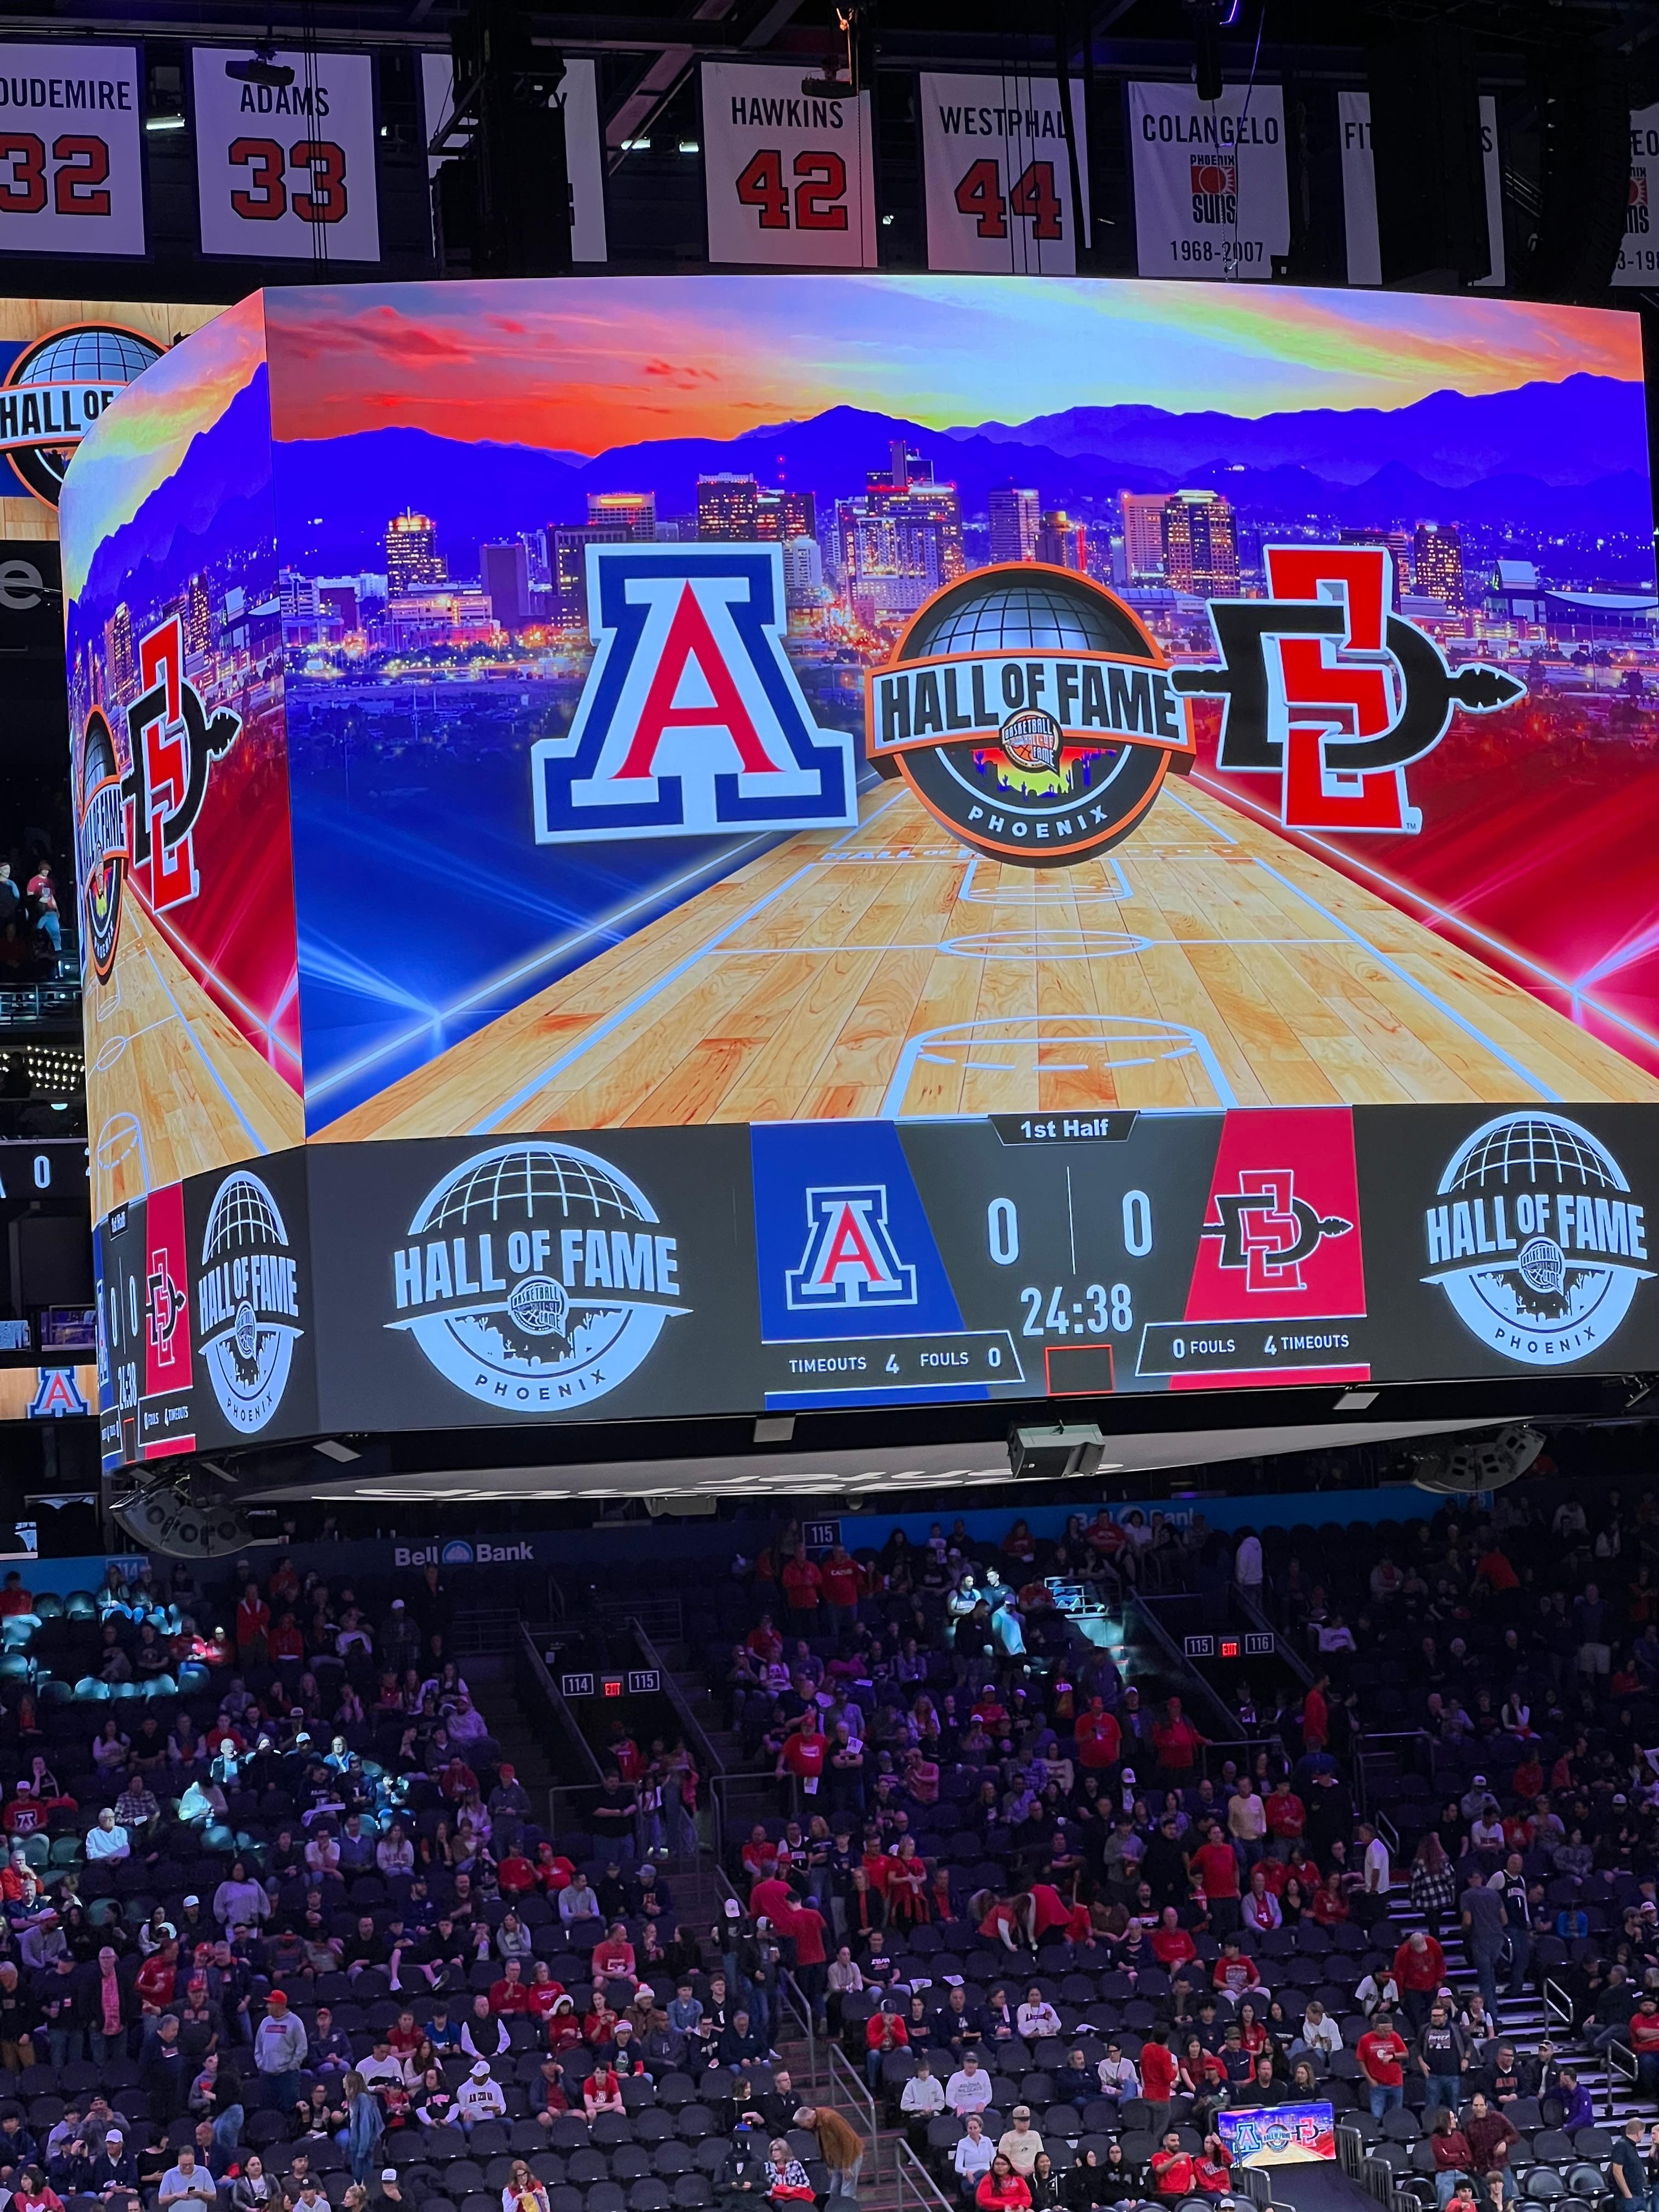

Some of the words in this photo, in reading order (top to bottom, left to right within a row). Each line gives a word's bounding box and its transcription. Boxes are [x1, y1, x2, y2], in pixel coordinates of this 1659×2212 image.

[240, 84, 329, 116] ADAMS
[732, 97, 843, 128] HAWKINS
[939, 106, 1066, 138] WESTPHAL
[1143, 114, 1279, 144] COLANGELO
[0, 132, 111, 216] 32
[228, 137, 348, 223] 33
[736, 149, 848, 230] 42
[954, 159, 1063, 240] 44
[1171, 241, 1263, 262] 1968-2007
[0, 390, 81, 438] HALL
[531, 542, 859, 845] A
[881, 665, 1000, 742] HALL
[1002, 663, 1045, 708] OF
[1056, 664, 1179, 739] FAME
[1005, 718, 1052, 740] BASKETBALL
[1032, 746, 1054, 767] FAME
[968, 805, 1108, 839] PHOENIX
[821, 851, 915, 860] HALL
[1020, 1120, 1056, 1138] 1st
[1064, 1119, 1109, 1137] Half
[33, 1155, 51, 1189] 0
[988, 1197, 1019, 1266] 0
[1122, 1189, 1153, 1257] 0
[1426, 1195, 1518, 1265] HALL
[1516, 1194, 1550, 1234] OF
[1556, 1194, 1648, 1260] FAME
[785, 1184, 918, 1310] A
[394, 1234, 506, 1310] HALL
[508, 1230, 551, 1273] OF
[560, 1229, 680, 1295] FAME
[111, 1287, 117, 1347] 0
[129, 1274, 138, 1337] 0
[198, 1262, 235, 1336] HALL
[233, 1256, 249, 1299] OF
[251, 1255, 299, 1317] FAME
[1020, 1283, 1133, 1337] 24:38
[1172, 1339, 1186, 1359] 0
[1190, 1339, 1235, 1354] FOULS
[1263, 1335, 1277, 1355] 4
[1281, 1334, 1349, 1351] TIMEOUTS
[1494, 1325, 1596, 1354] PHOENIX
[789, 1357, 867, 1373] TIMEOUTS
[885, 1353, 900, 1374] 4
[920, 1351, 969, 1367] FOULS
[988, 1347, 1001, 1368] 0
[27, 1366, 92, 1419] A
[475, 1369, 606, 1401] PHOENIX
[227, 1391, 273, 1422] PHOENIX
[812, 1525, 833, 1543] 115
[394, 1546, 438, 1566] Bell
[476, 1542, 534, 1562] Bank
[1191, 1639, 1209, 1654] 115
[1222, 1643, 1237, 1656] EXIT
[1251, 1636, 1269, 1651] 116
[568, 1677, 588, 1692] 114
[605, 1683, 620, 1696] EXIT
[634, 1674, 654, 1689] 115
[718, 2010, 725, 2024] 1
